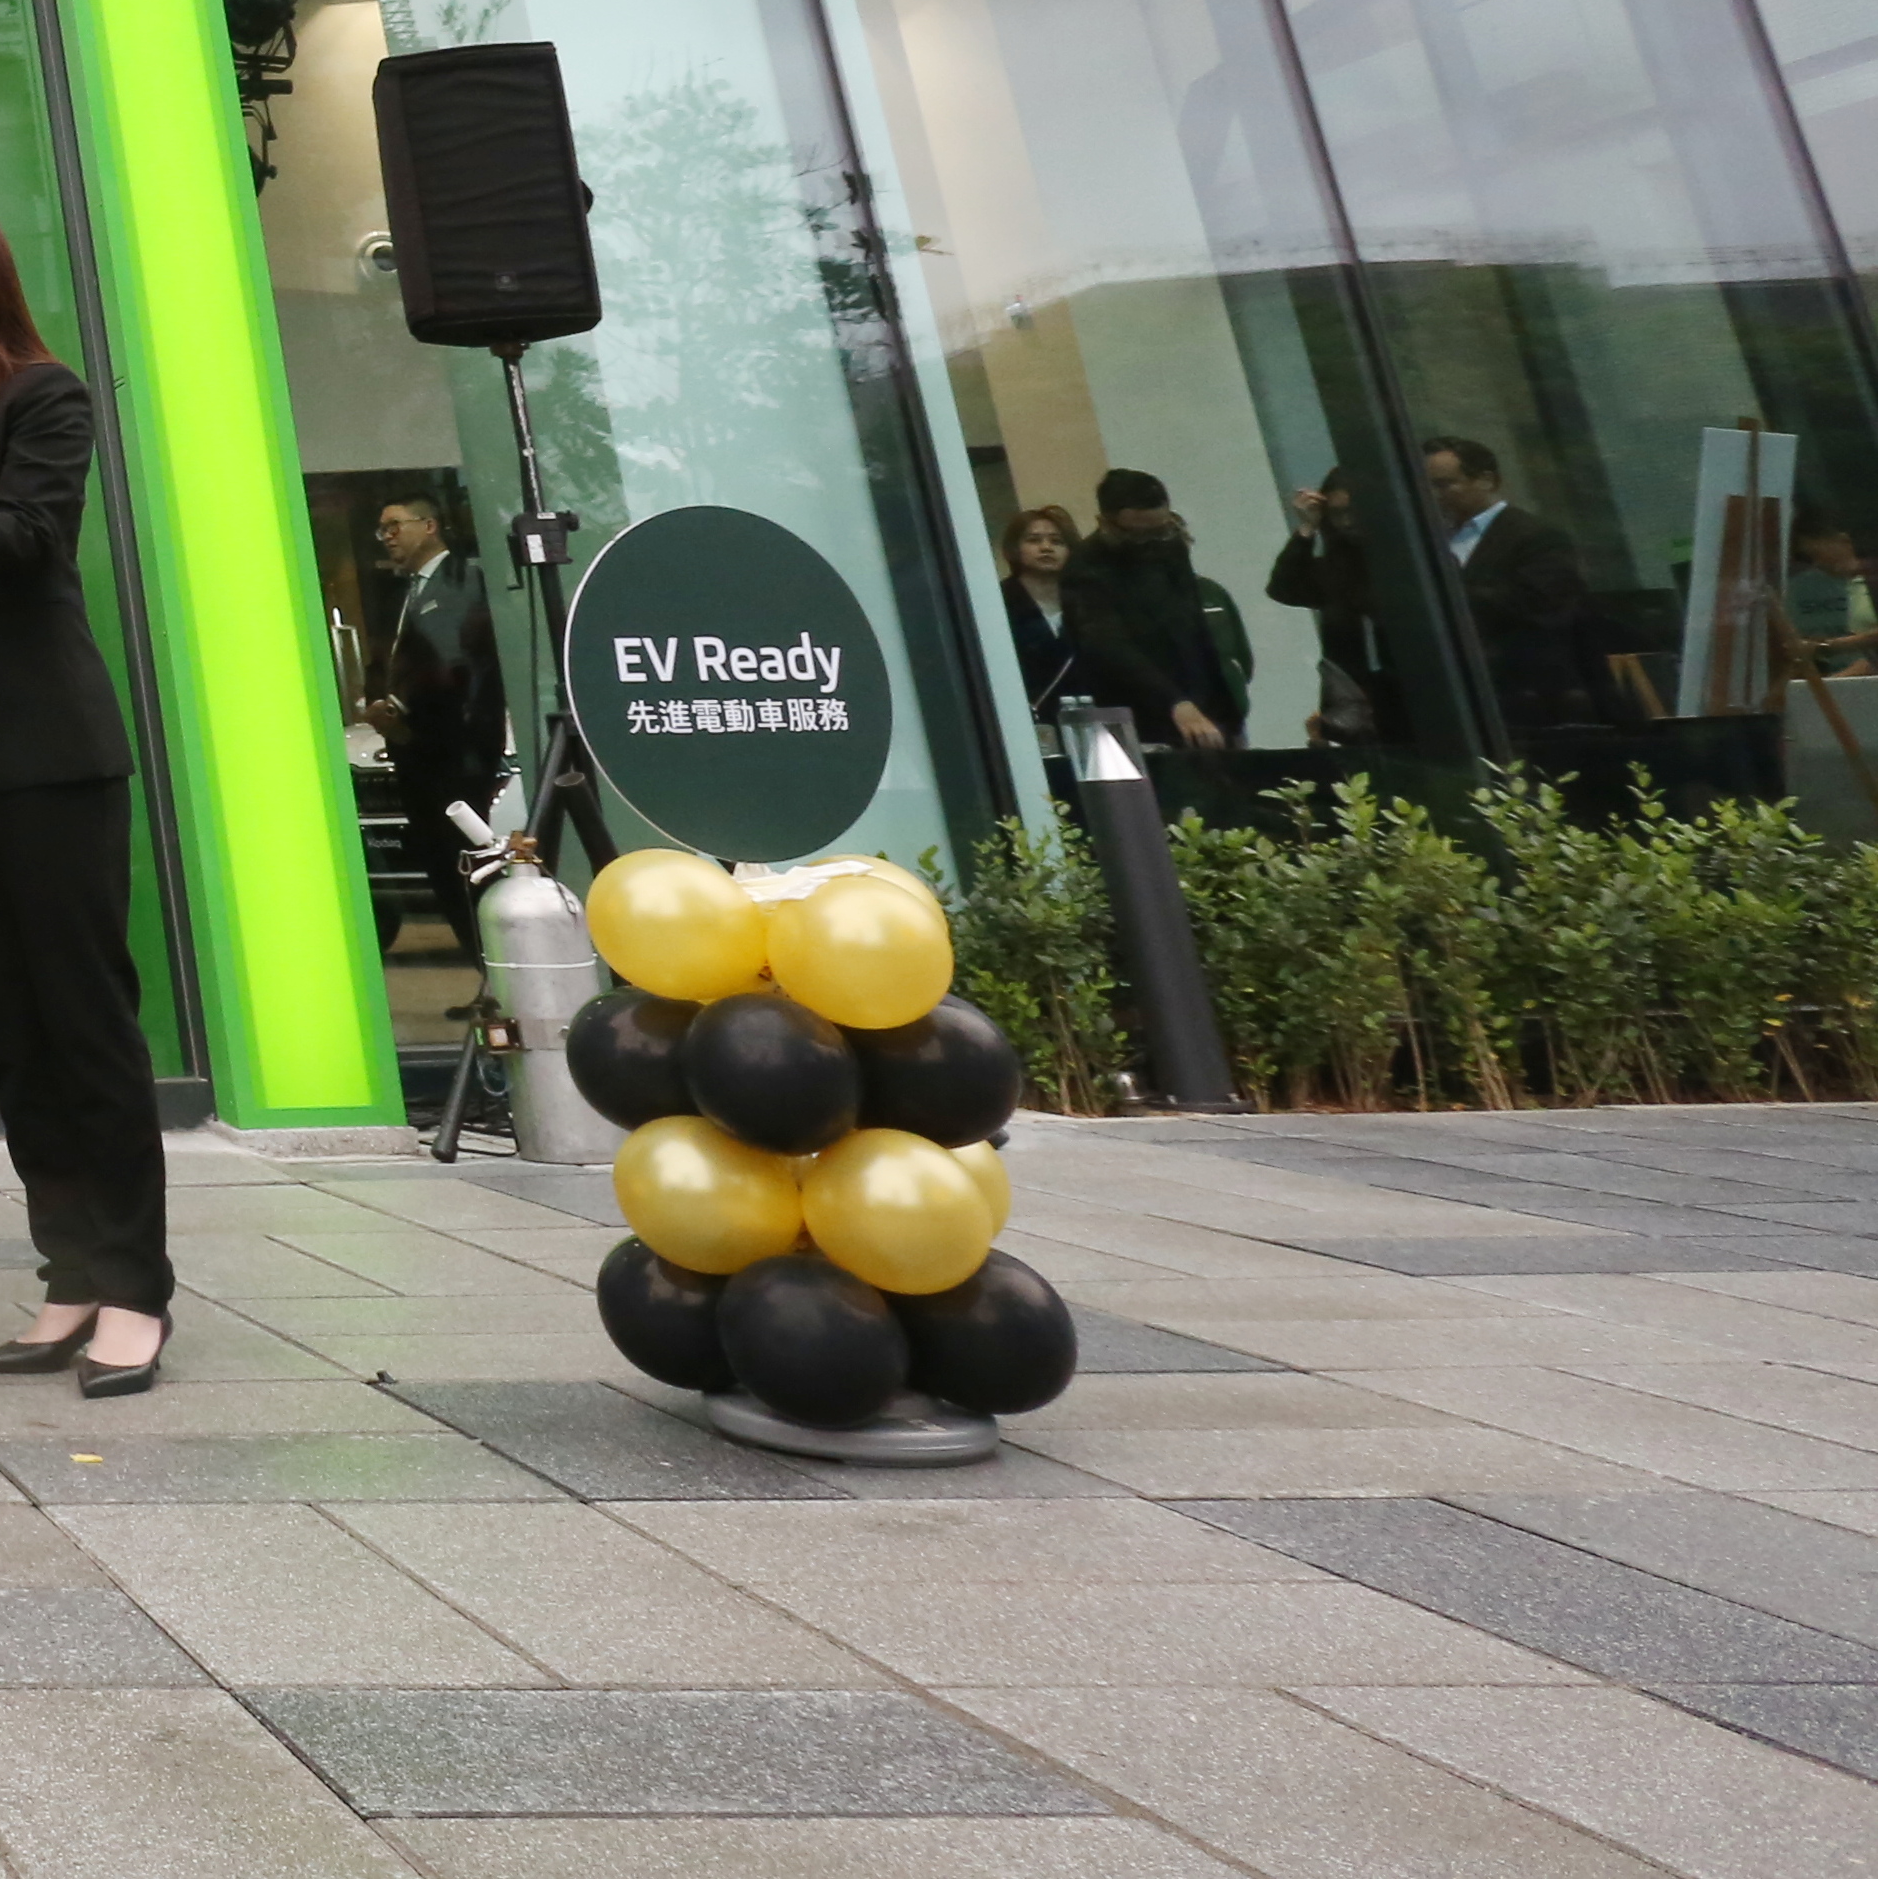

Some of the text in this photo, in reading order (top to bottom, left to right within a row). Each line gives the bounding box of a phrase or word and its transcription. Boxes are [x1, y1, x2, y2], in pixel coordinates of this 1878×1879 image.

[614, 631, 841, 693] EV Ready
[627, 699, 849, 734] 先進電動車服務
